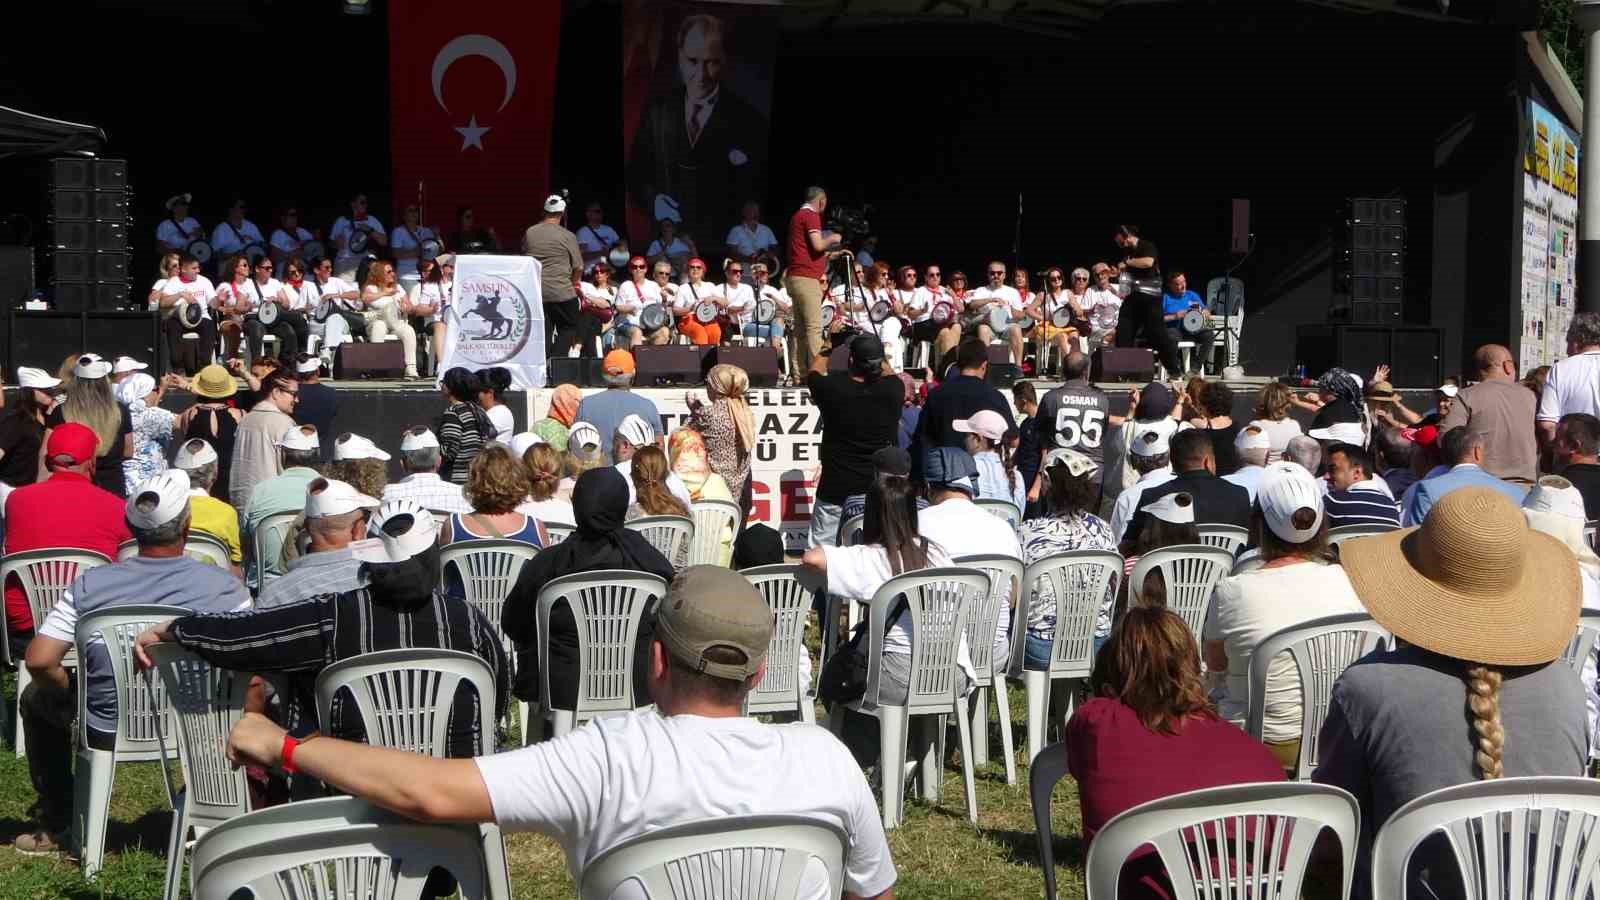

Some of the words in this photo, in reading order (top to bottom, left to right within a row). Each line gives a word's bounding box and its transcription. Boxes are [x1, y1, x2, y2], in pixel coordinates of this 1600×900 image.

[462, 282, 511, 293] SAMSUN
[1062, 395, 1098, 406] OSMAN
[1055, 407, 1105, 448] 55
